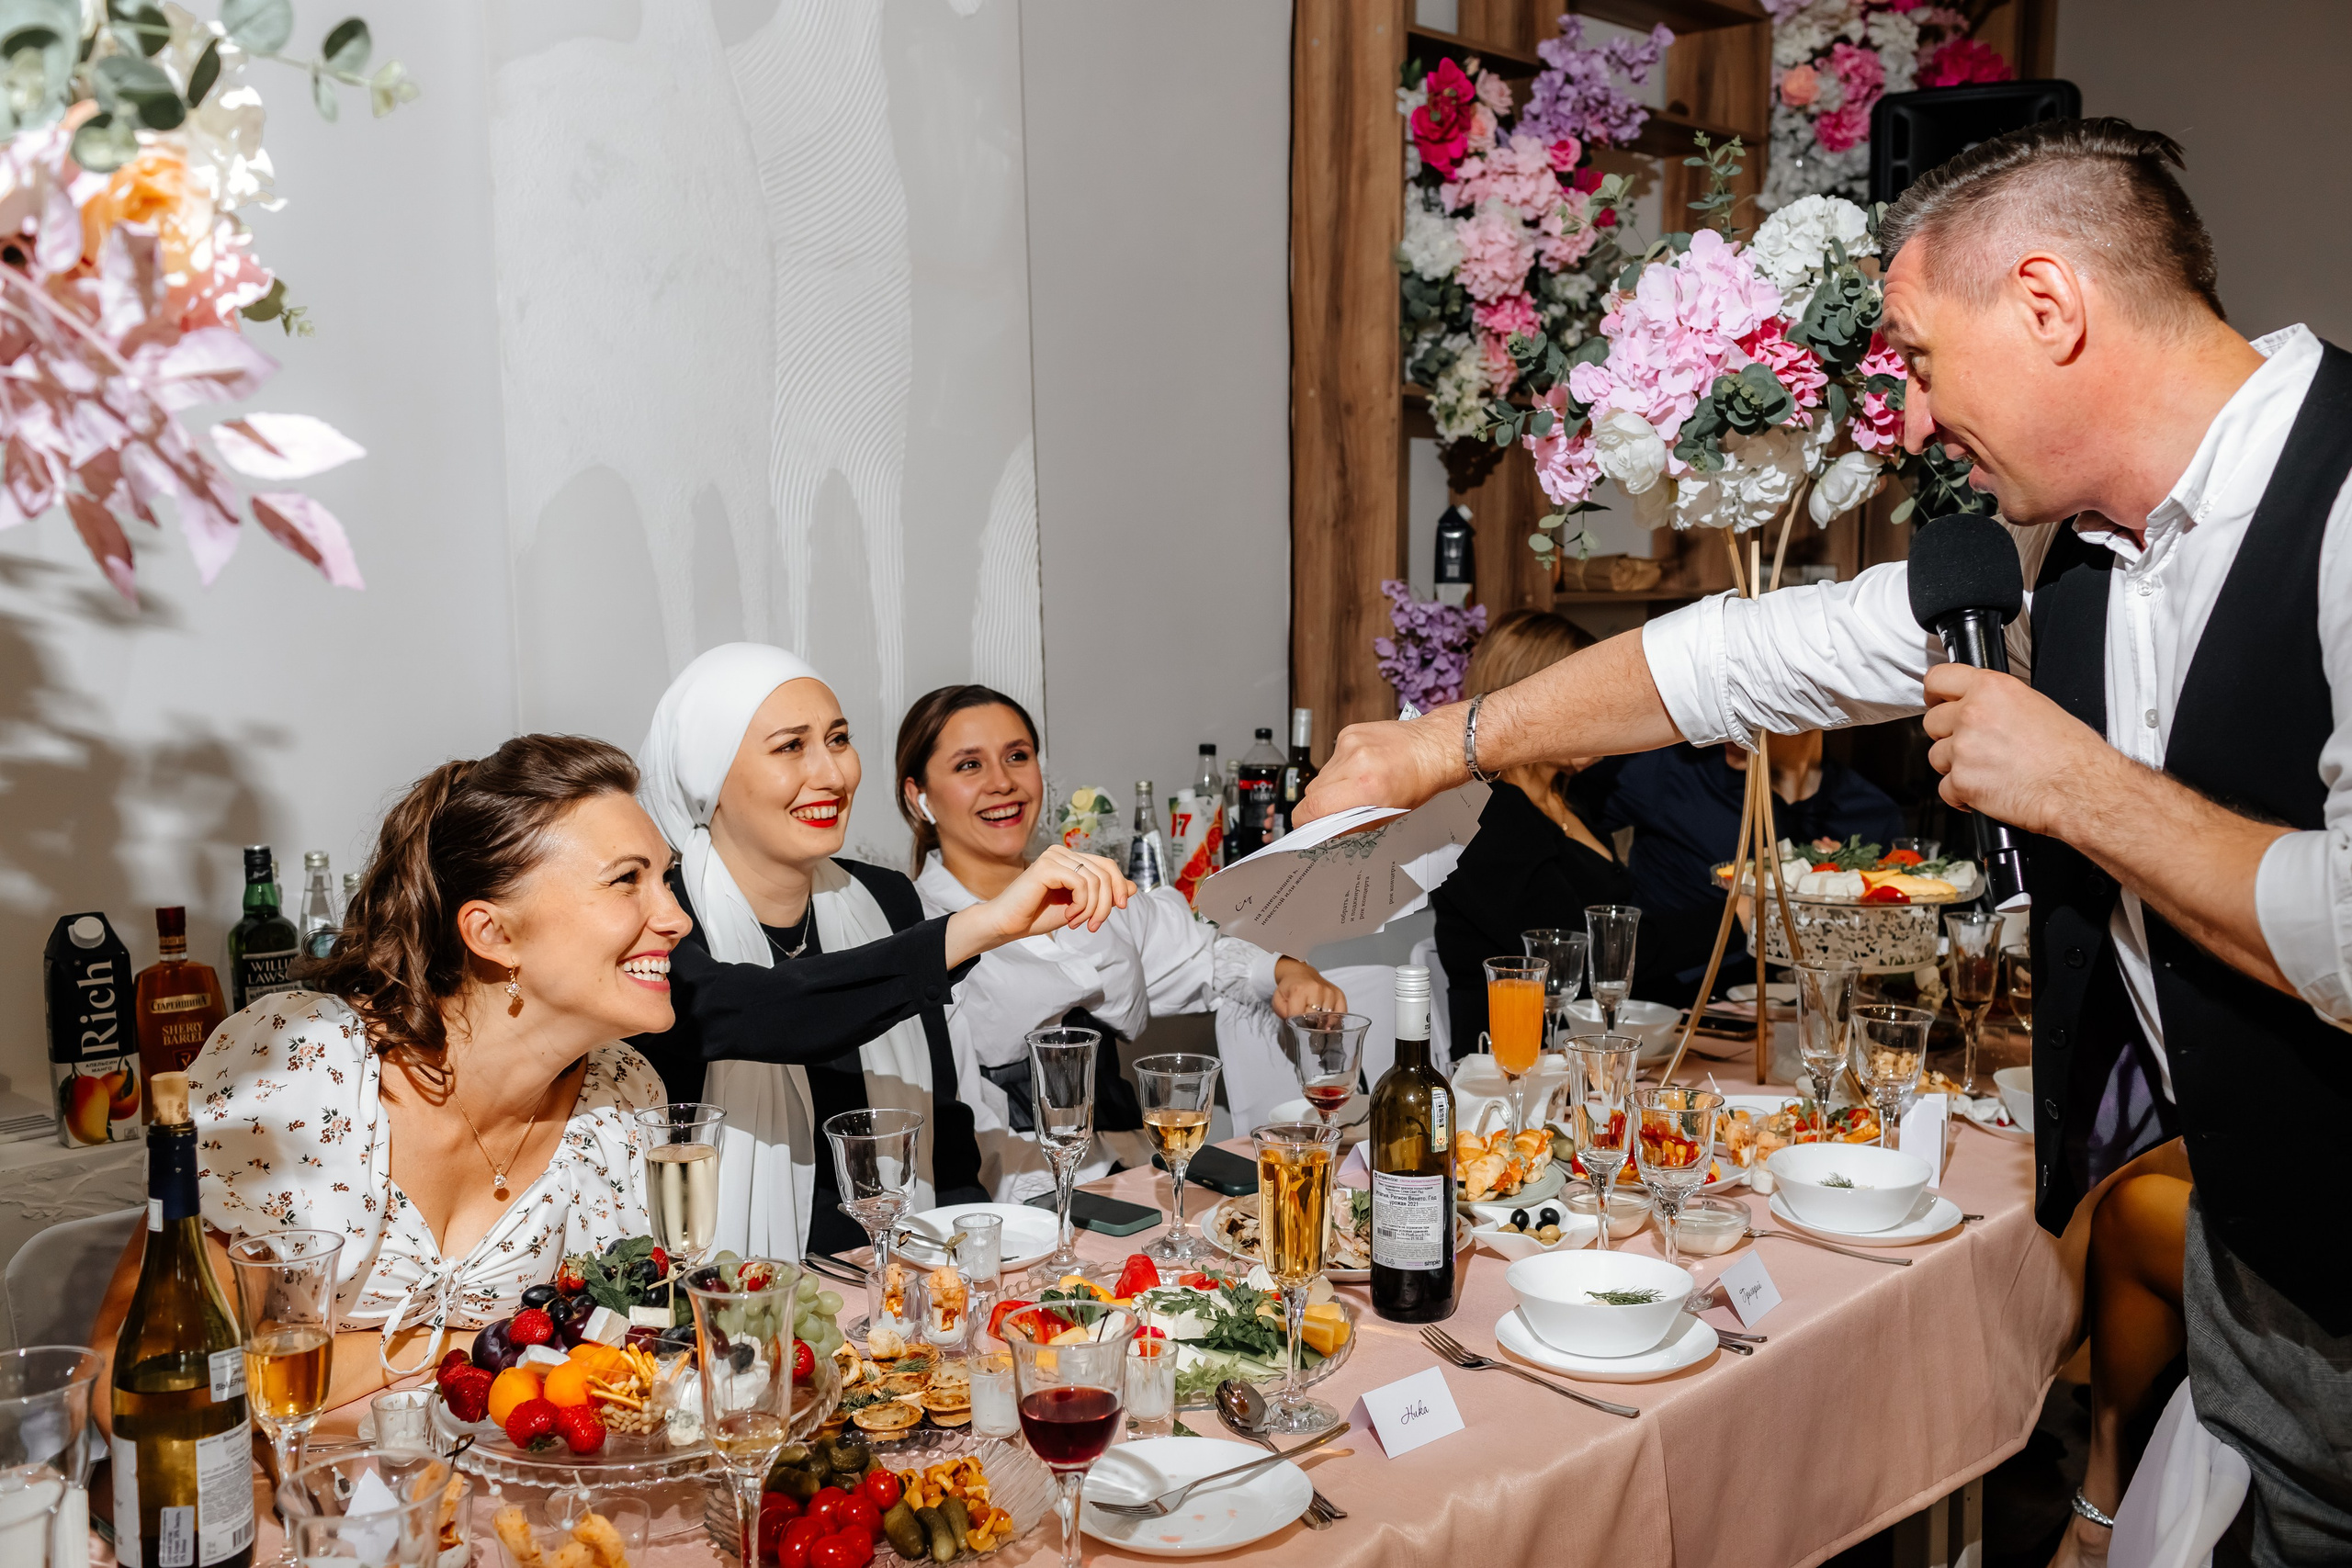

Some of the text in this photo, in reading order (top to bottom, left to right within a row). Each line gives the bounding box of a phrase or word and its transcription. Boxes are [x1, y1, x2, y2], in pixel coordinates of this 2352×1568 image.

[1254, 874, 1294, 921] на танец вашей
[1261, 897, 1286, 926] невестой
[1284, 885, 1296, 897] или
[1351, 882, 1360, 917] подкинуть
[1362, 875, 1370, 907] концерта
[1340, 897, 1349, 924] собрать
[248, 971, 288, 985] LAWS
[76, 959, 119, 1057] Rich
[162, 1021, 204, 1035] SHERRY
[163, 1032, 205, 1046] BARREL
